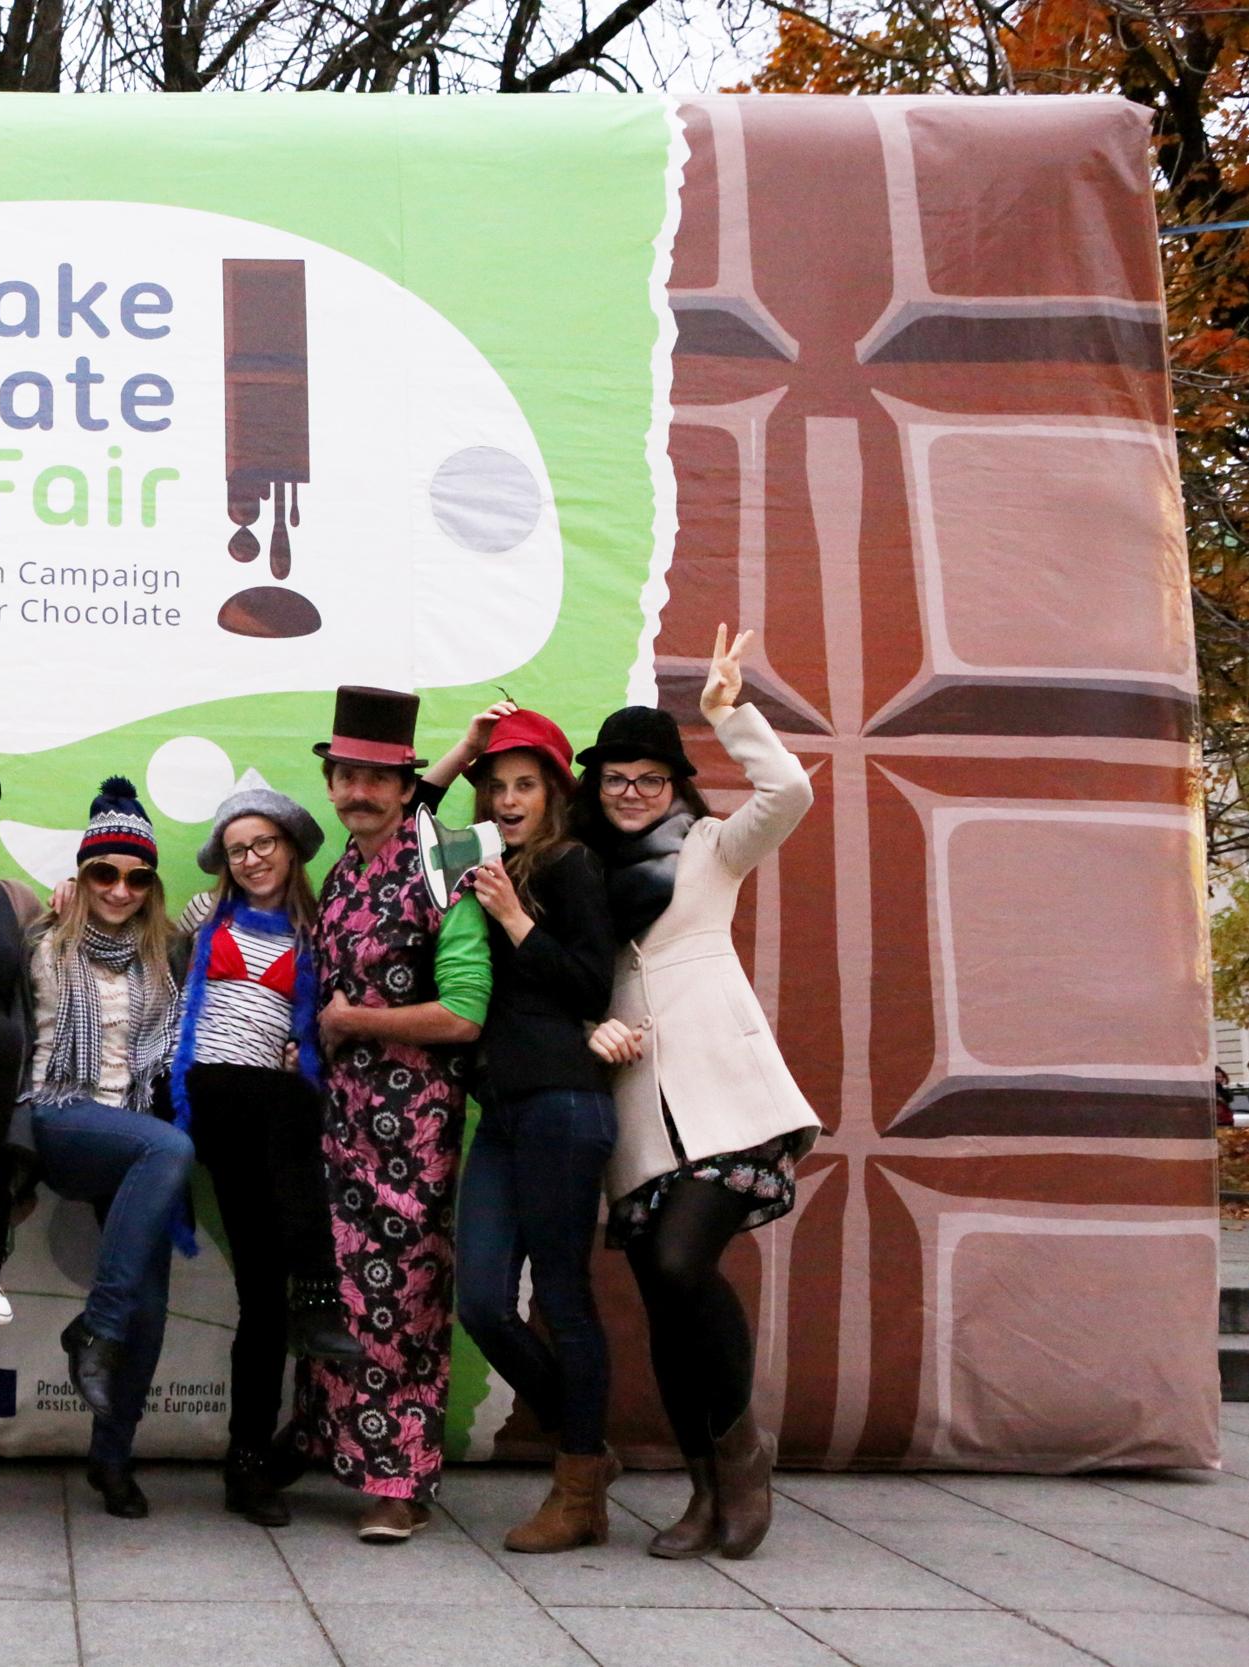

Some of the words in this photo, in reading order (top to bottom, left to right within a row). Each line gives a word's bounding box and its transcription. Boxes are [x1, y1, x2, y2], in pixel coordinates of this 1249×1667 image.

[19, 561, 181, 595] Campaign
[20, 599, 181, 627] Chocolate
[36, 1380, 77, 1397] Produ
[169, 1381, 226, 1398] financial
[36, 1399, 89, 1413] assista
[164, 1398, 227, 1415] European
